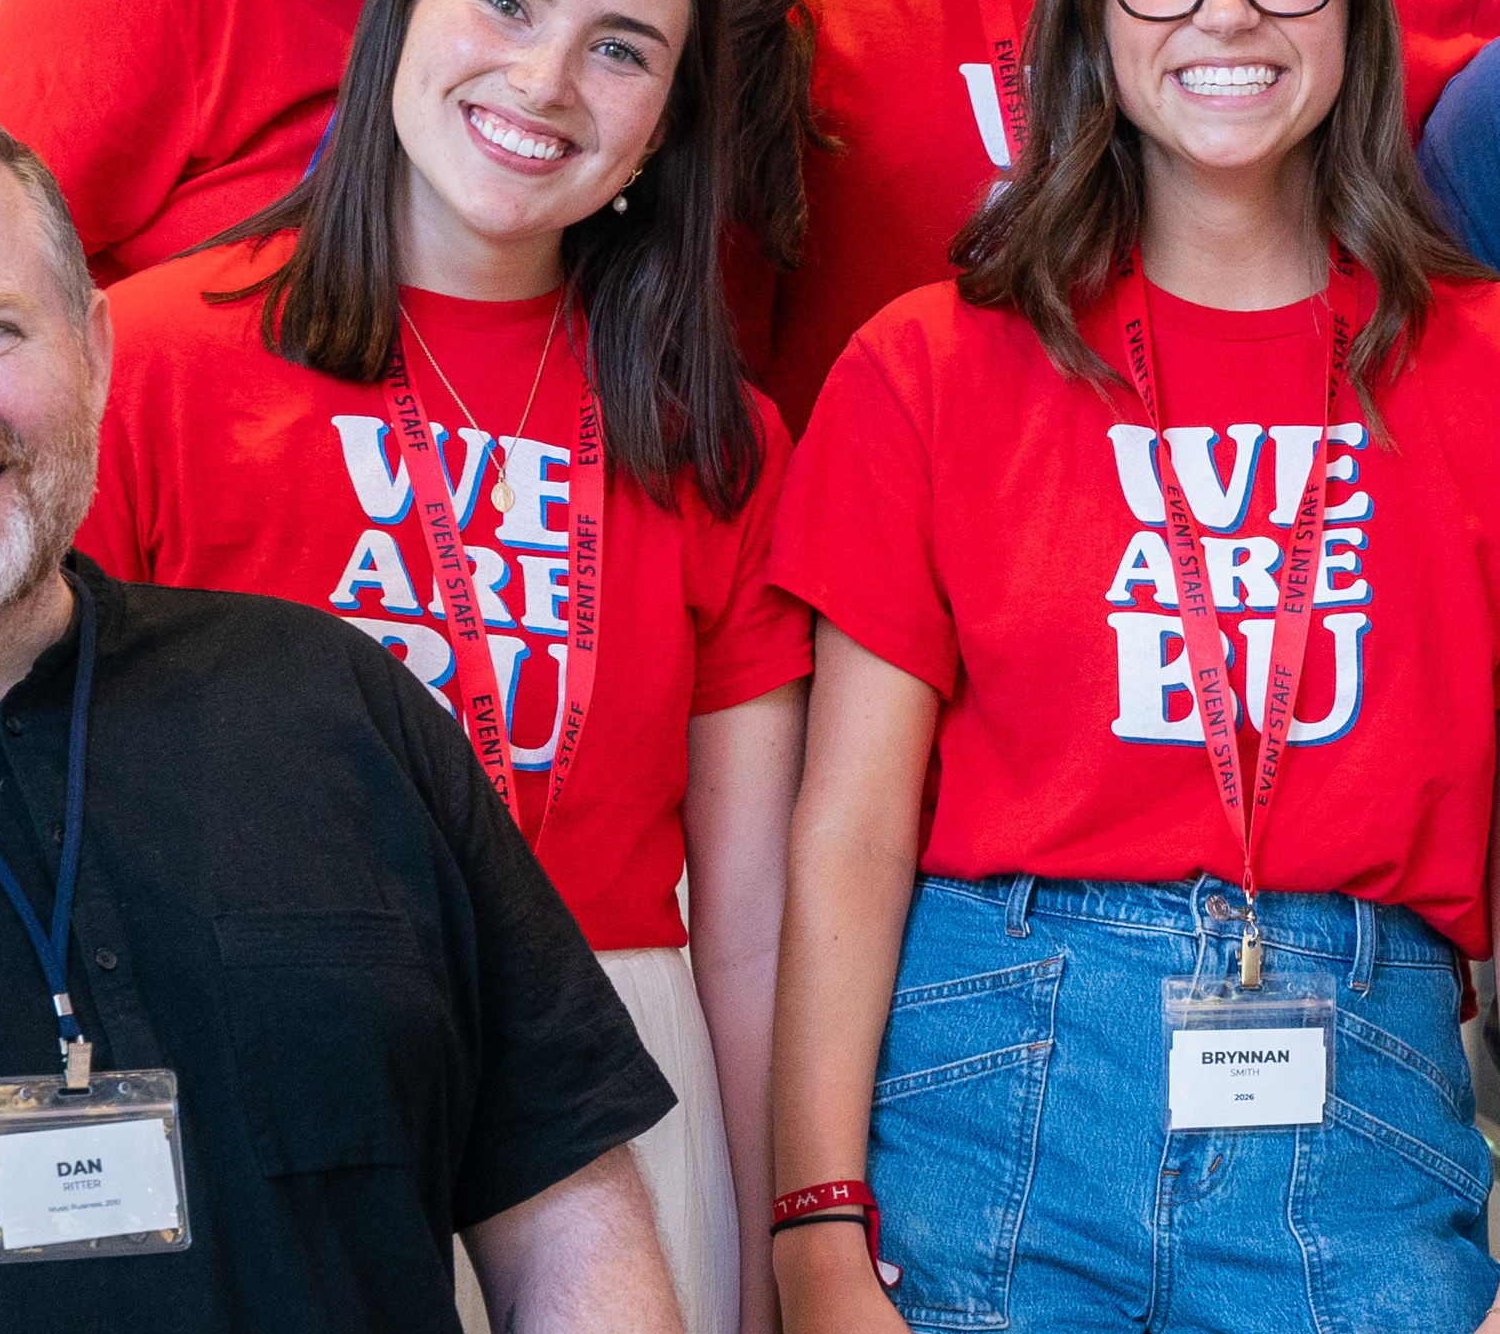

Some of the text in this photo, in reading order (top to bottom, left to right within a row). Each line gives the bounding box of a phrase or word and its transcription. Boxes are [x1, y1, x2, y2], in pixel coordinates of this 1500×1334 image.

[1125, 319, 1148, 381] EVENT
[1332, 315, 1350, 374] STAFF
[394, 394, 429, 452] STAFF
[578, 406, 598, 465] EVENT
[331, 414, 571, 552] WE
[1106, 422, 1374, 533] WE
[329, 529, 570, 636] ARE
[425, 501, 480, 642] EVENT STAFF
[575, 513, 598, 651] EVENT STAFF
[1104, 528, 1374, 613] ARE
[1166, 484, 1207, 617] EVENT STAFF
[1284, 483, 1320, 614] EVENT STAFF
[1107, 612, 1372, 747] BU
[472, 694, 503, 767] EVENT
[559, 701, 584, 768] STAFF
[1199, 667, 1239, 808] EVENT STAFF
[1257, 663, 1294, 807] EVENT STAFF
[1201, 1050, 1290, 1065] BRYNNAN
[1230, 1068, 1260, 1077] SMITH
[57, 1158, 103, 1177] DAN
[63, 1180, 101, 1192] RITTER
